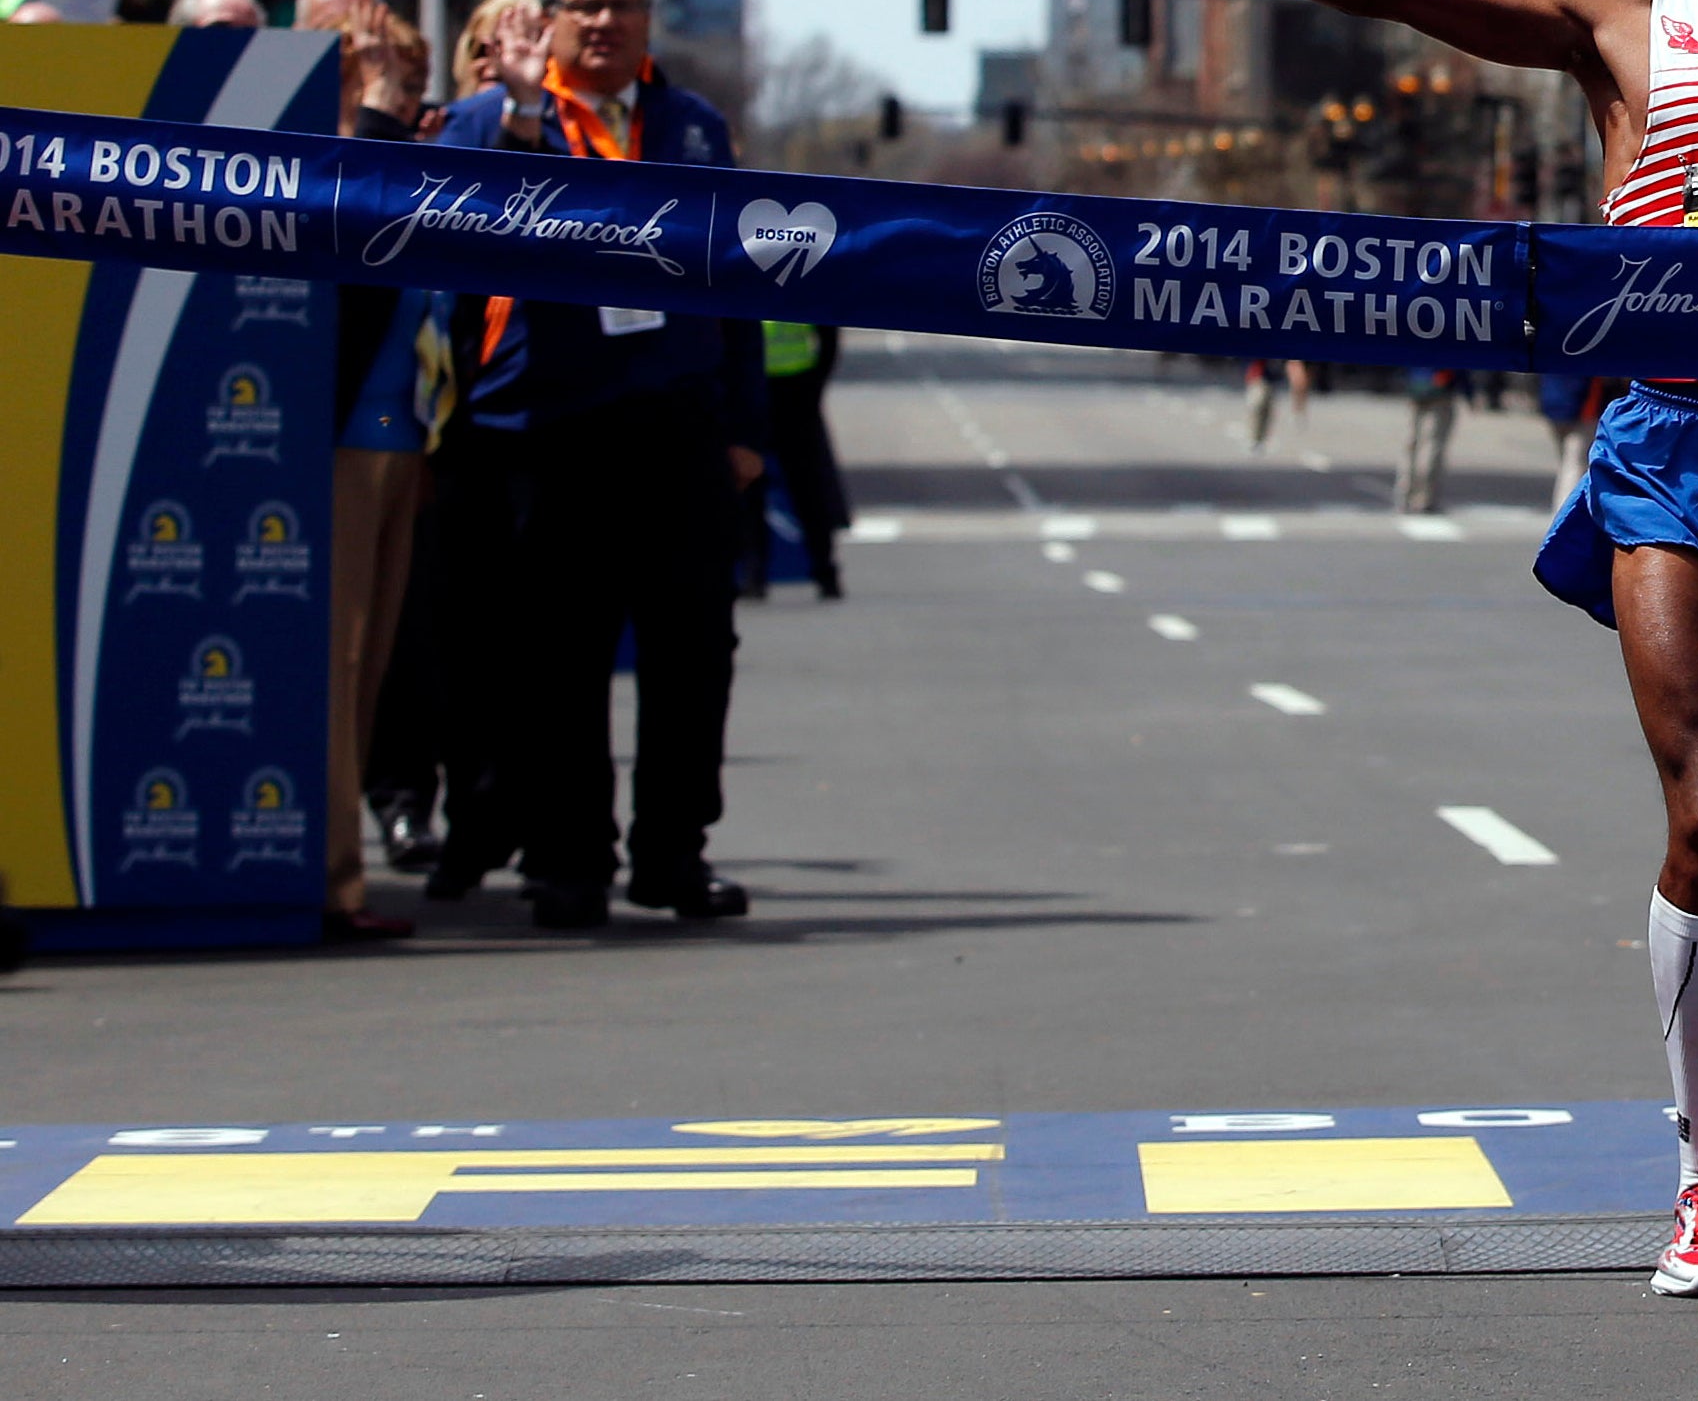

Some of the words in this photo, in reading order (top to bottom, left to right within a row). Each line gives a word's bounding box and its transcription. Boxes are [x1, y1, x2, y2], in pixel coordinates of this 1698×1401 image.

[90, 140, 301, 199] BOSTON
[362, 171, 488, 266] John
[486, 177, 685, 276] Hancock
[754, 227, 816, 244] BOSTON
[1134, 222, 1252, 272] 2014
[1279, 232, 1493, 286] BOSTON
[983, 248, 1002, 303] BOSTON
[998, 217, 1066, 249] ATHLETIC
[1067, 223, 1111, 311] ASSOCIATION
[1133, 277, 1492, 342] MARATHON
[1562, 253, 1695, 355] John
